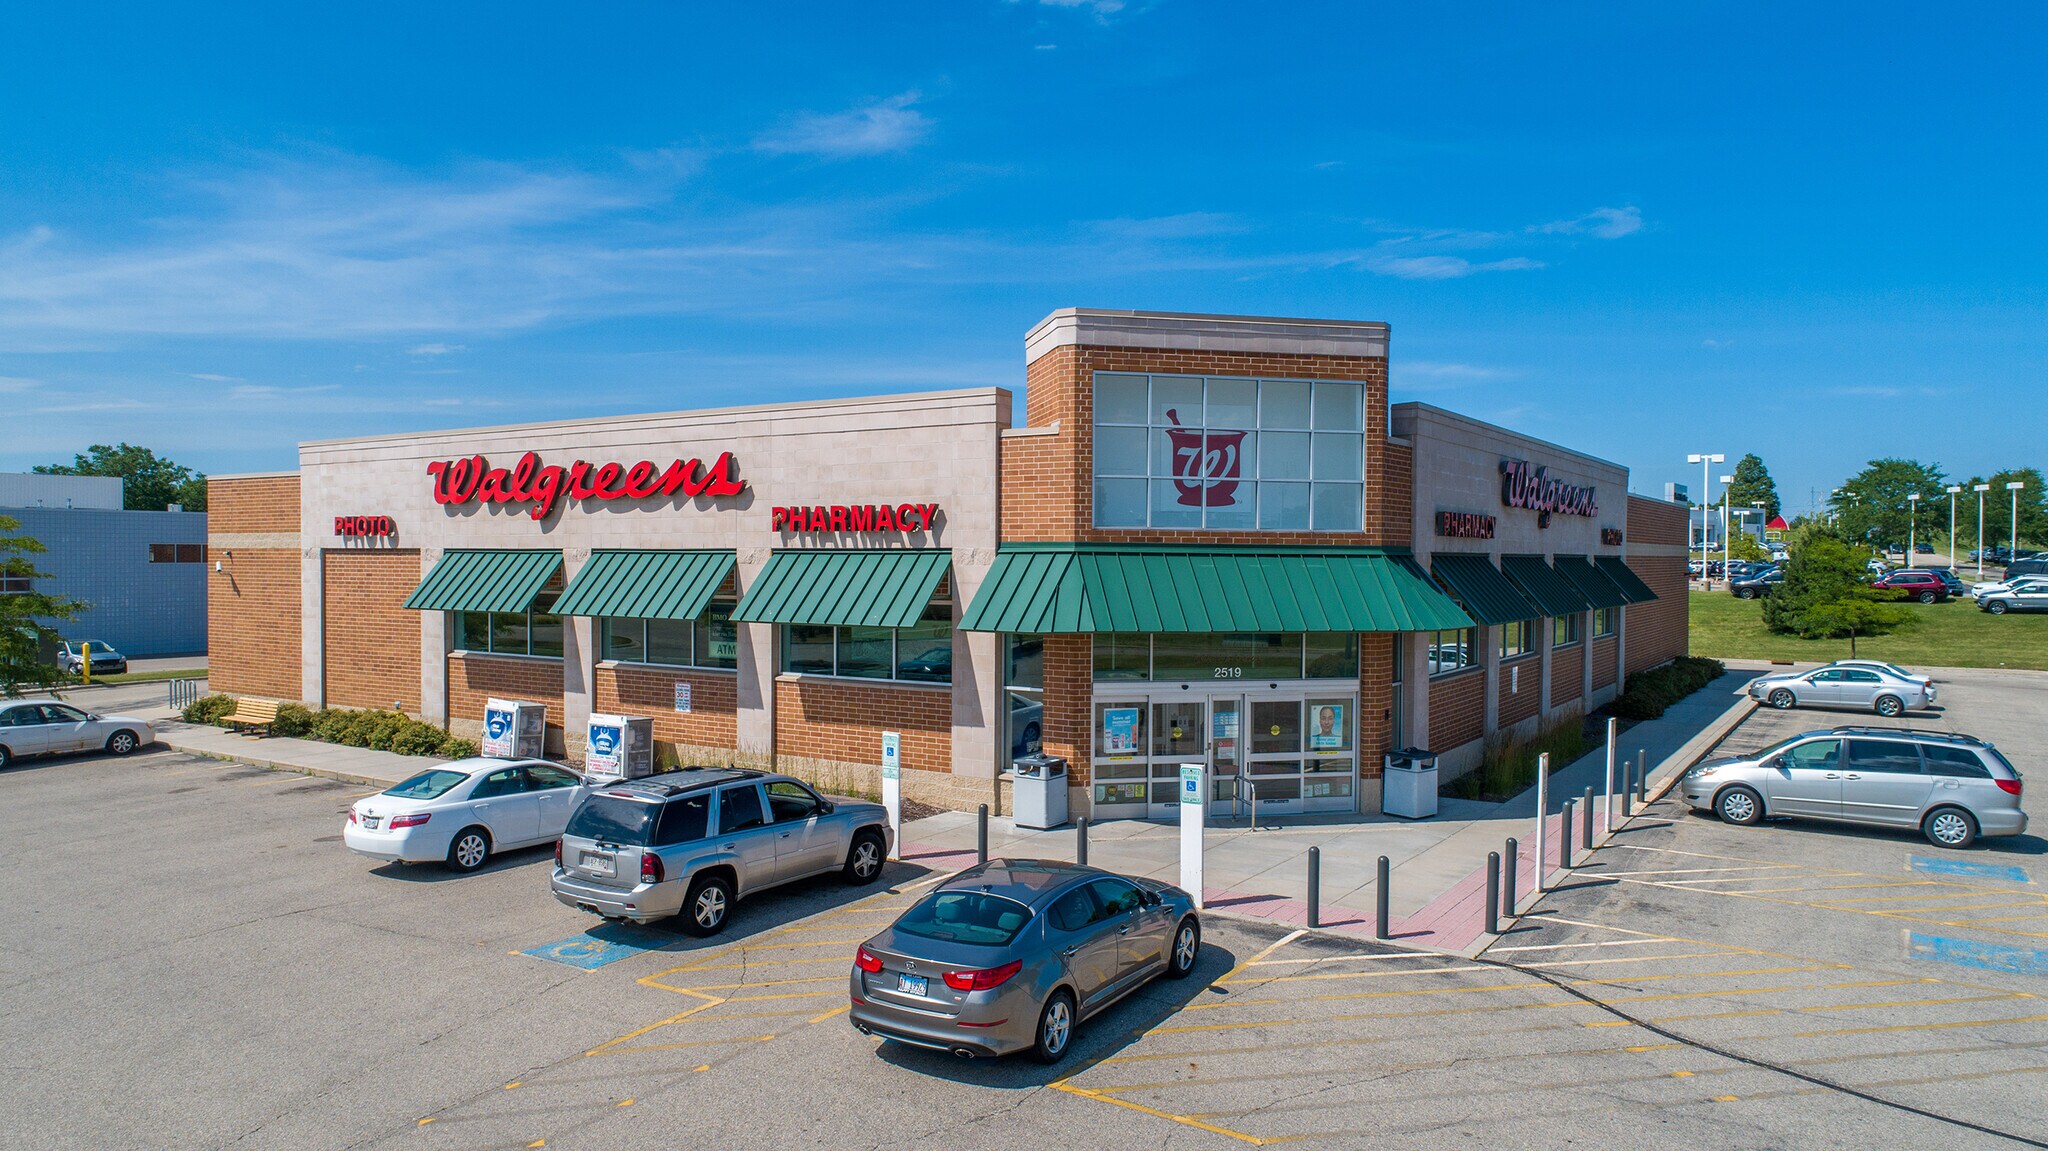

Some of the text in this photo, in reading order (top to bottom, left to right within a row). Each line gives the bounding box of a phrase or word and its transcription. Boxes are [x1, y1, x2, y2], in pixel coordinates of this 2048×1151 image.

[427, 451, 745, 520] Walgreens
[1504, 460, 1598, 529] Walgreens
[335, 515, 390, 536] PHOTO
[772, 503, 936, 533] PHARMACY
[1442, 511, 1496, 540] PHARMACY
[717, 644, 736, 655] ATM
[1214, 667, 1241, 678] 2519
